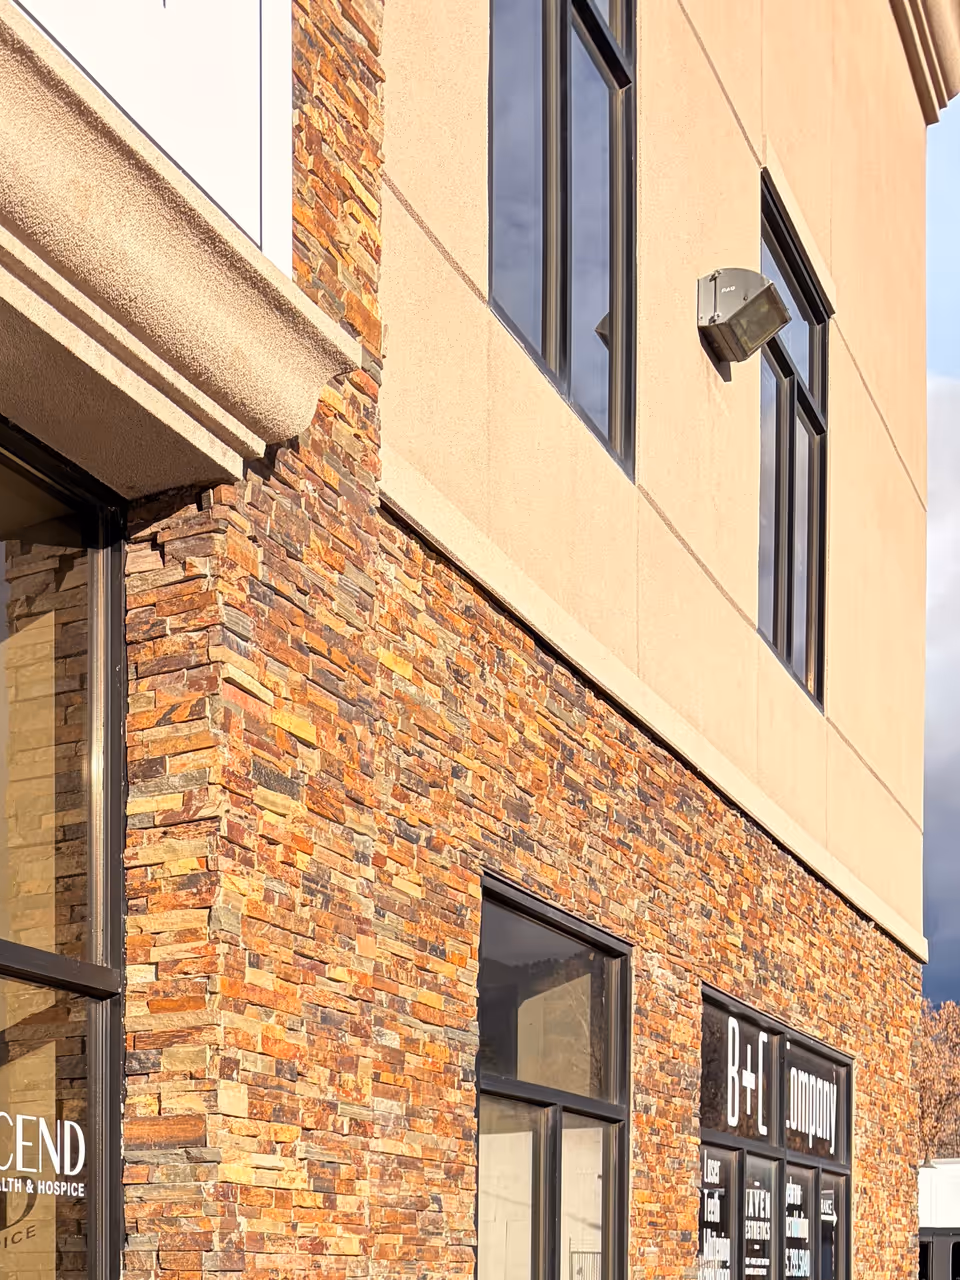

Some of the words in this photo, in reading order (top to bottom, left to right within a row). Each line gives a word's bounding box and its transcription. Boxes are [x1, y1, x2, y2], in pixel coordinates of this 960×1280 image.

[785, 1041, 837, 1154] ompany
[26, 1180, 34, 1194] &
[37, 1181, 85, 1197] HOSPICE
